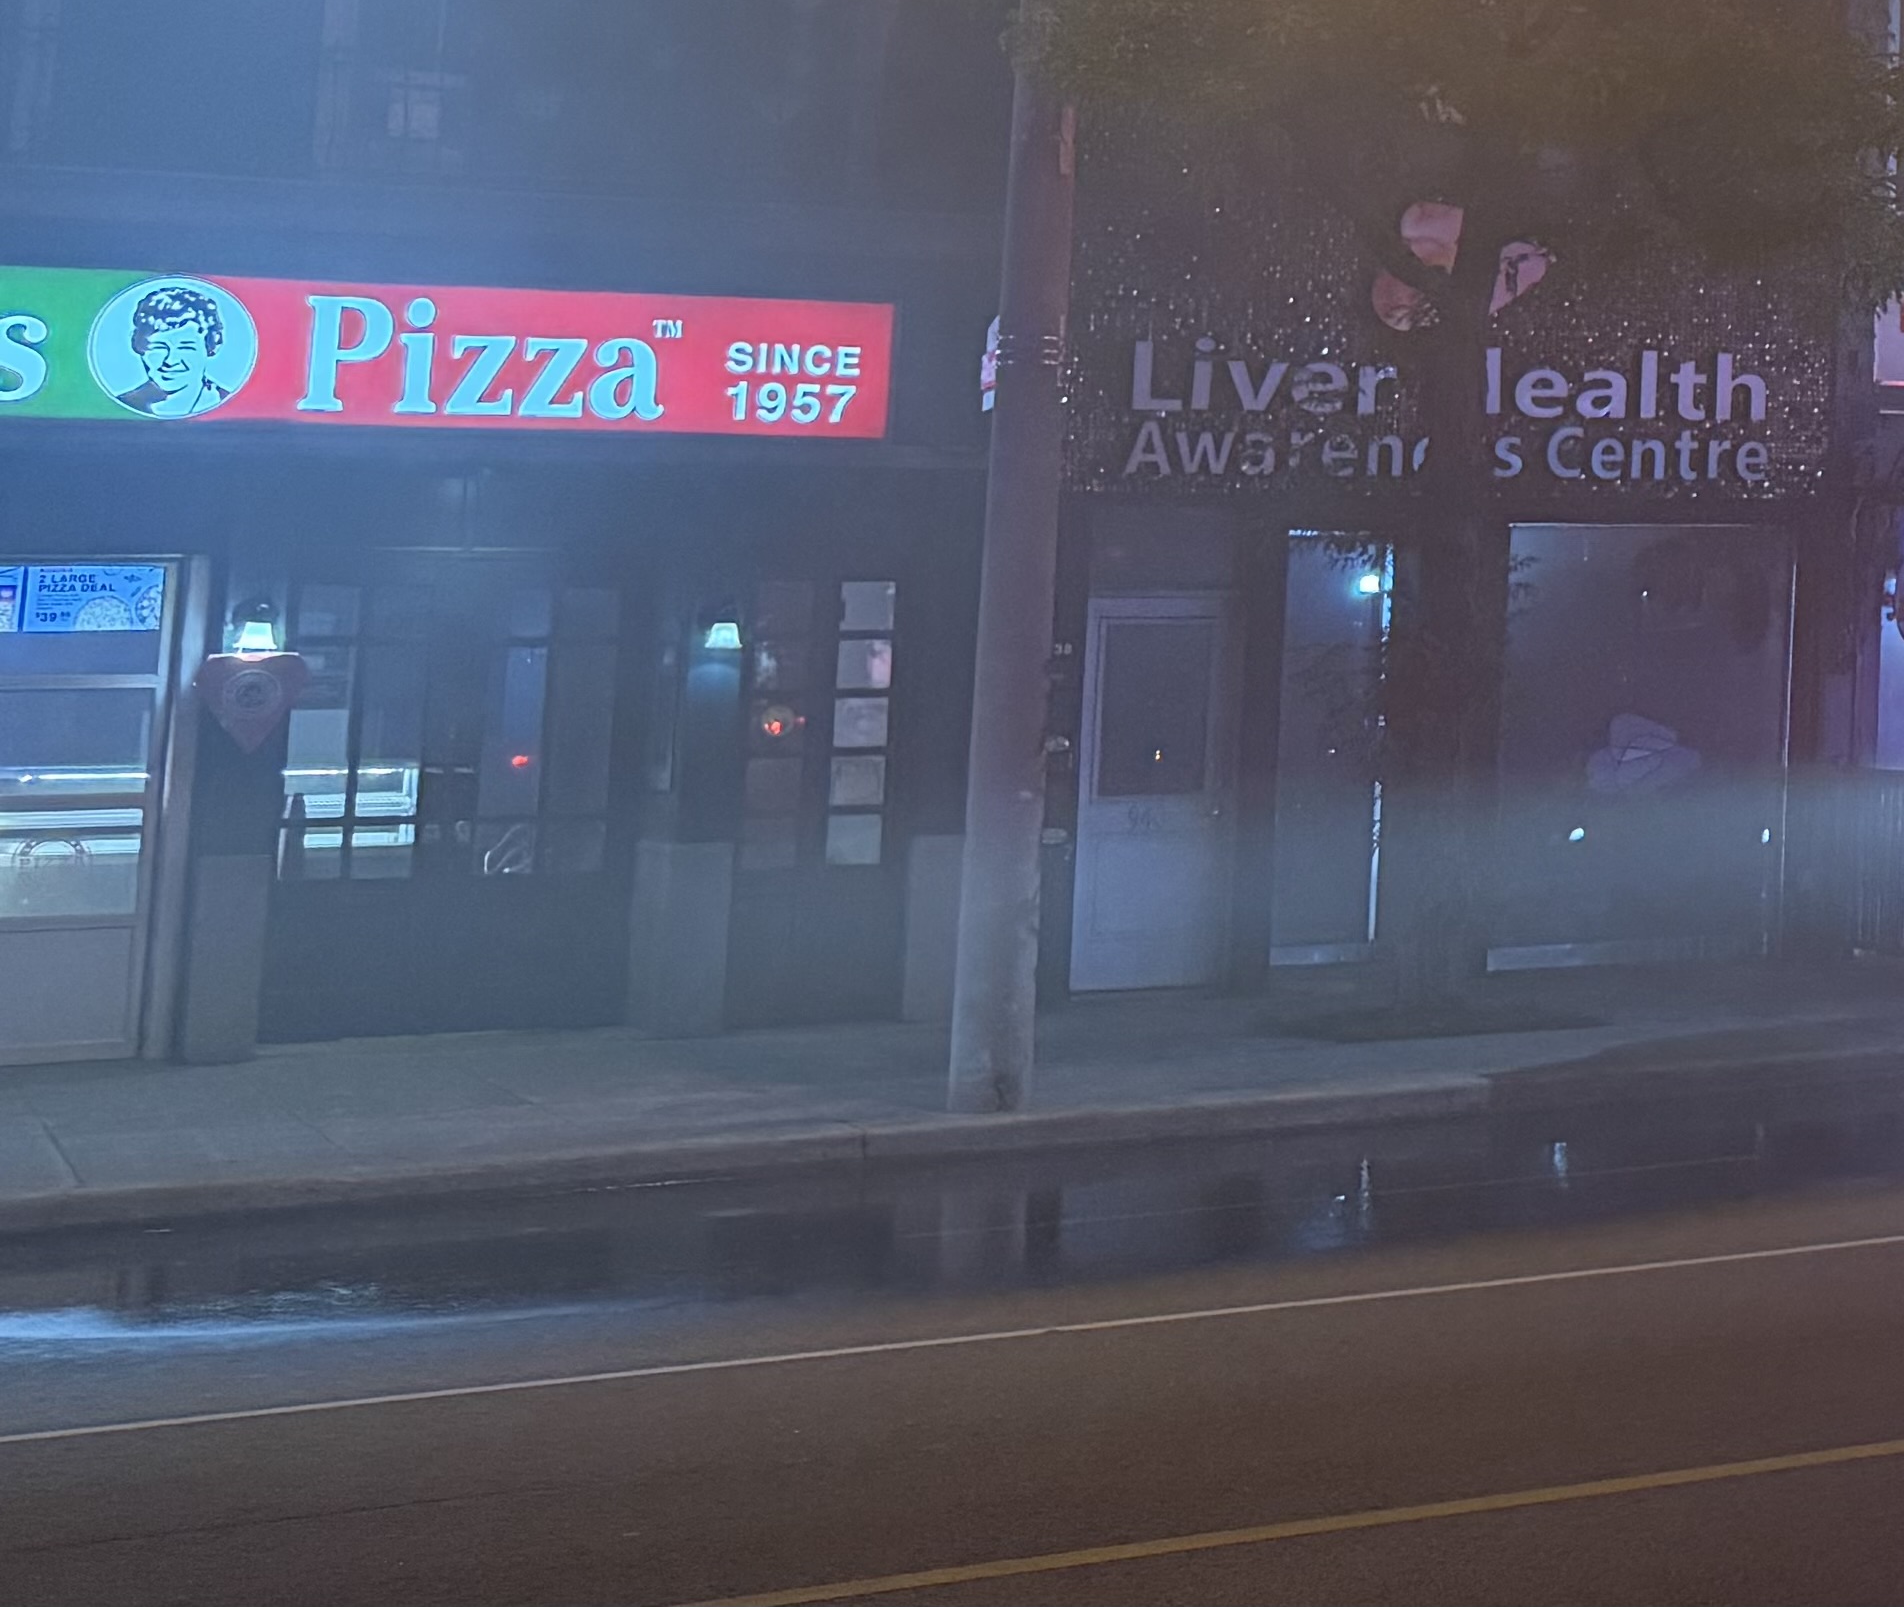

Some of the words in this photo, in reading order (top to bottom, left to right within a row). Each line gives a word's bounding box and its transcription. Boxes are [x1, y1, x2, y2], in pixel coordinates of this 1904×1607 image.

[297, 295, 665, 420] Pizza
[725, 342, 862, 377] SINCE
[1132, 337, 1398, 415] Liver
[726, 380, 858, 423] 1957
[1123, 421, 1523, 478] Awarens
[1547, 426, 1769, 481] Centre
[38, 584, 77, 593] PIZZA
[81, 583, 117, 593] DEAL
